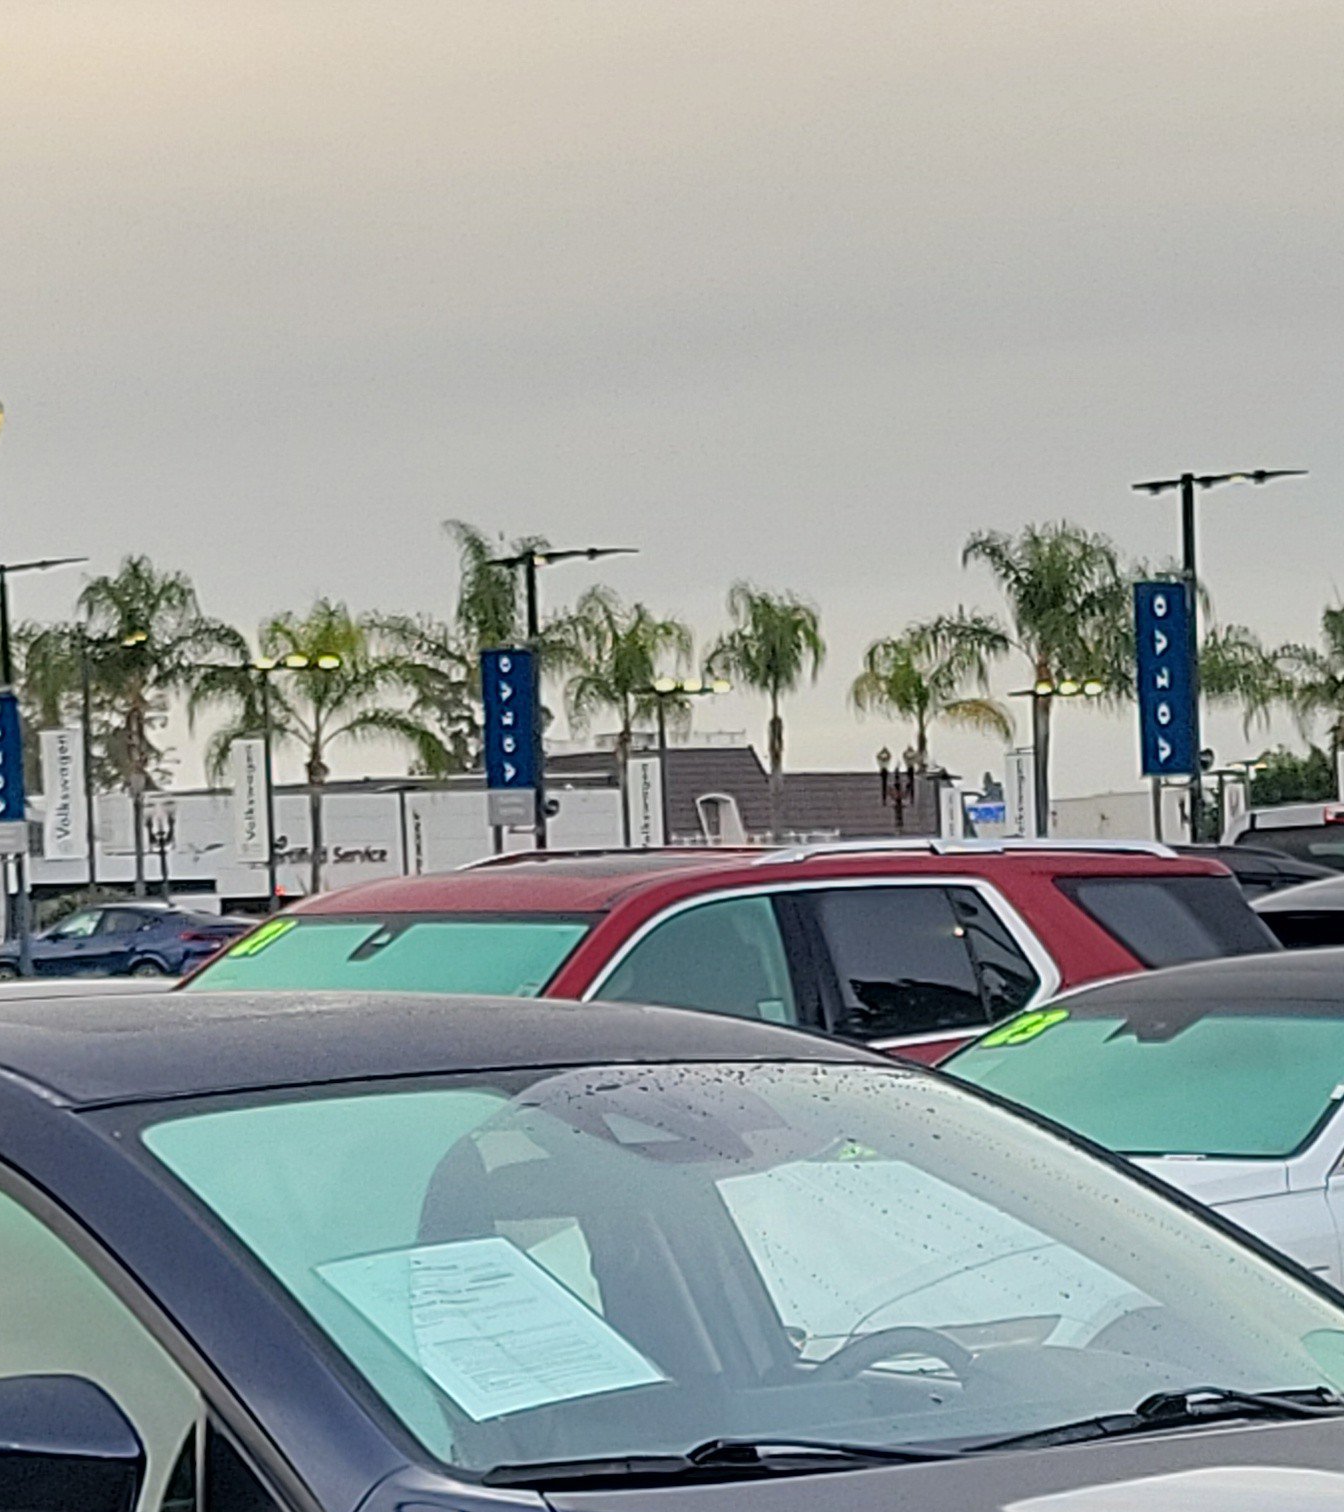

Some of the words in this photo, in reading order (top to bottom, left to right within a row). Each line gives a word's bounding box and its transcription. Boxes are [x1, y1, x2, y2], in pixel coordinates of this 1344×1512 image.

[499, 655, 516, 782] VOLVO
[1154, 594, 1172, 763] VOLVO
[56, 734, 72, 839] Volkswagen
[333, 846, 387, 864] Service
